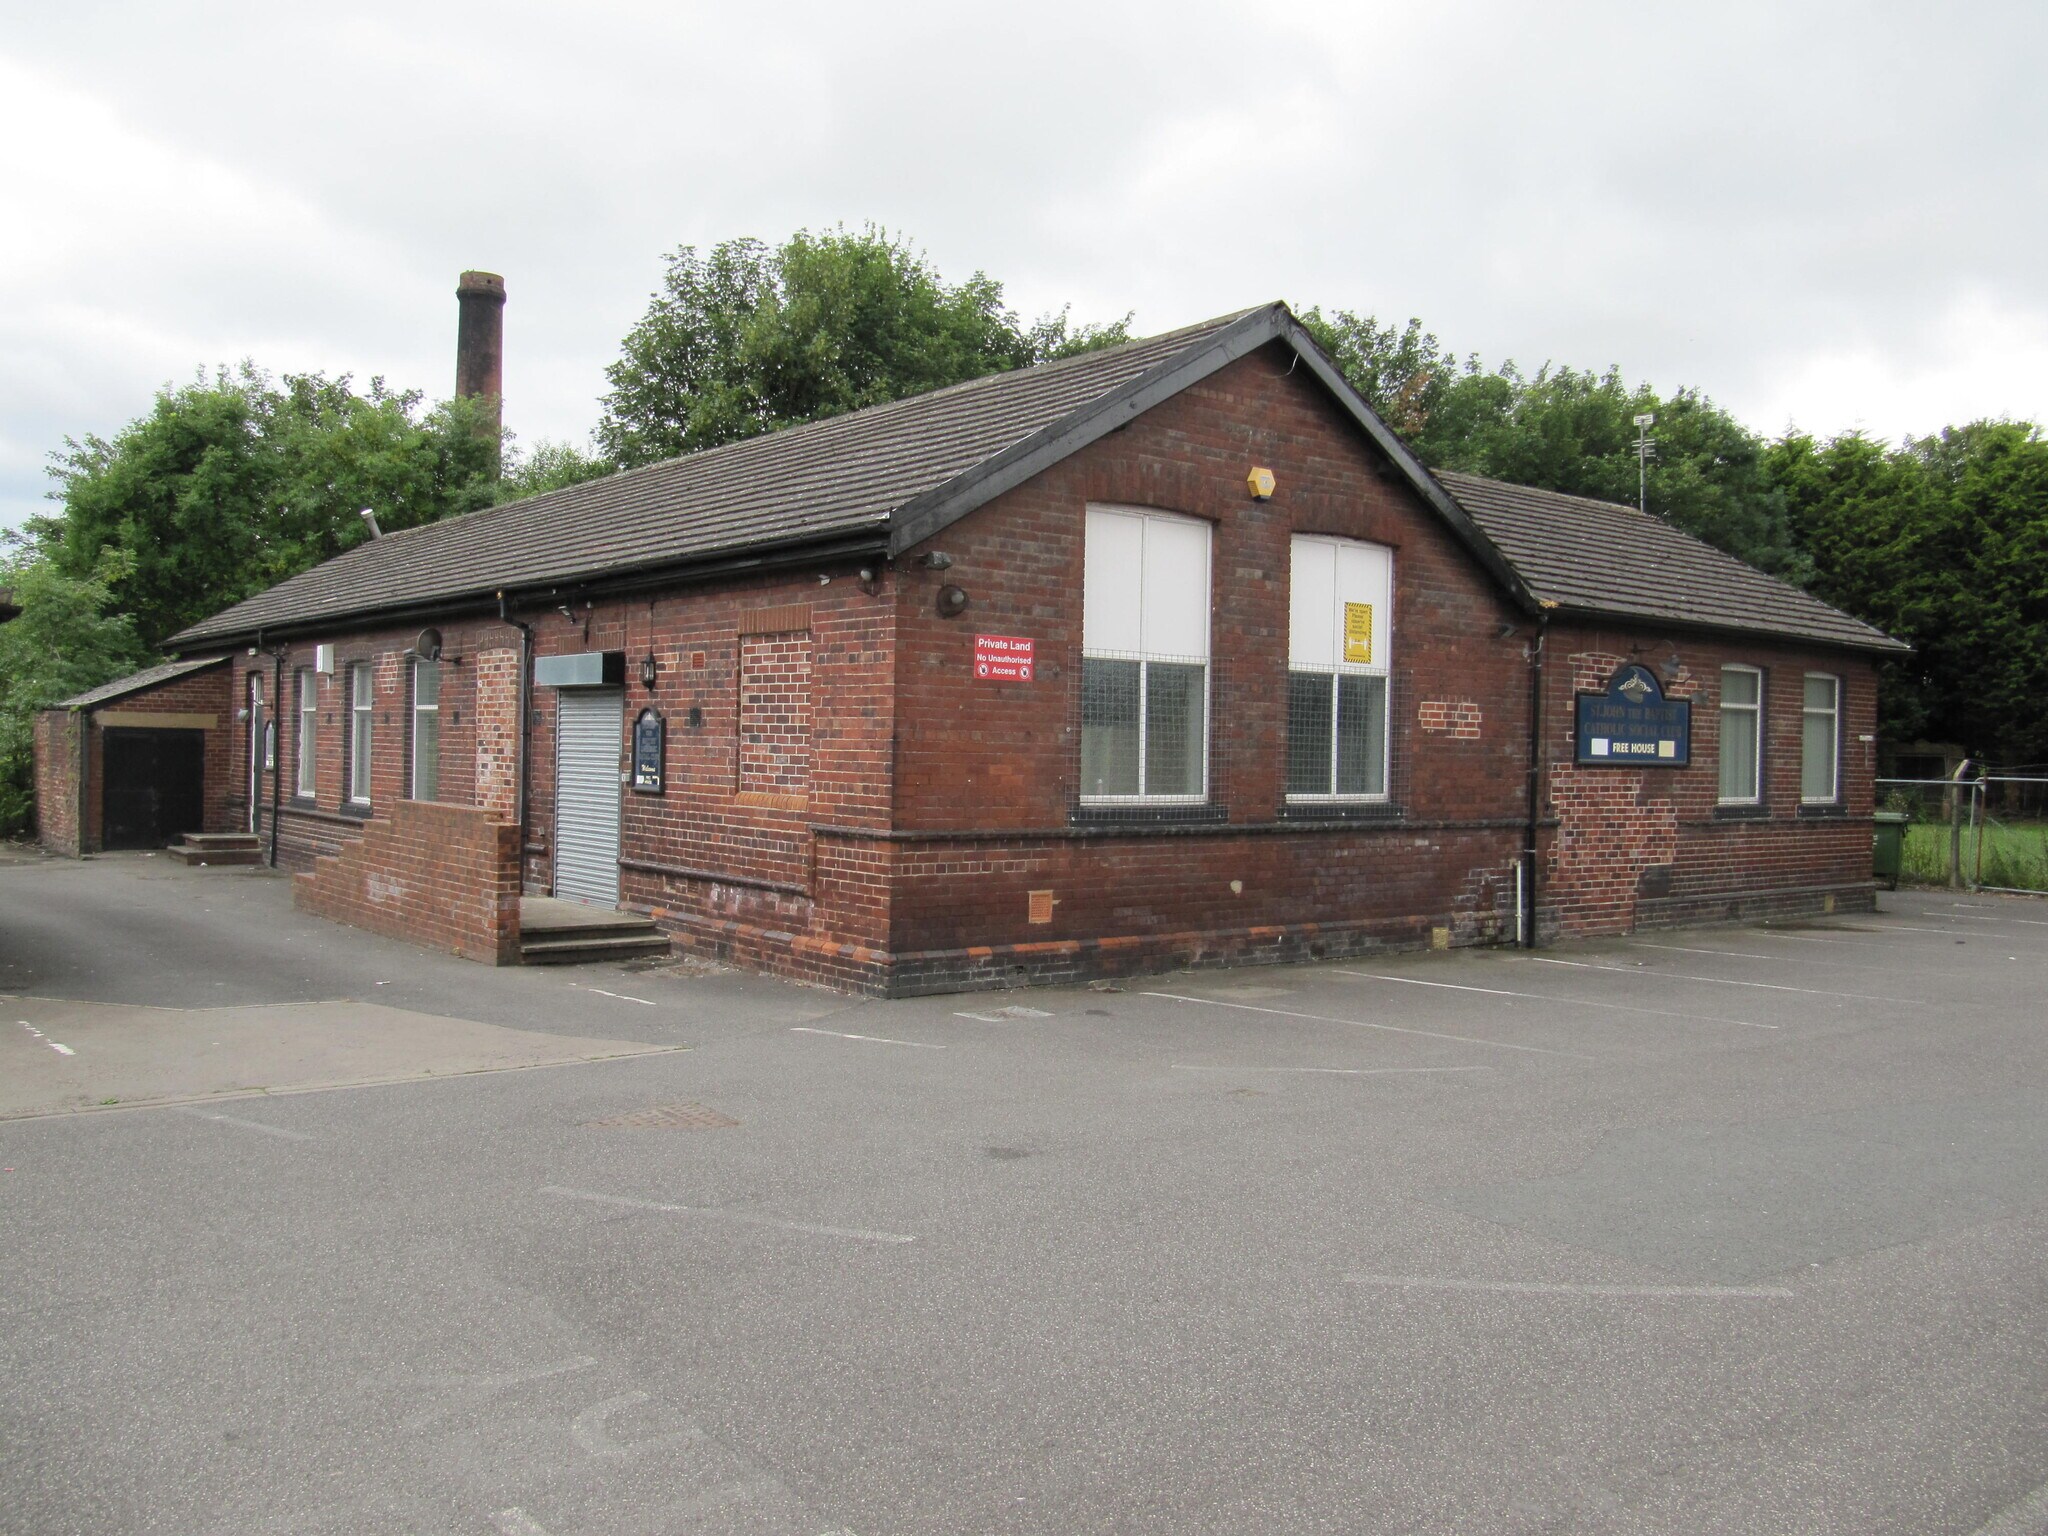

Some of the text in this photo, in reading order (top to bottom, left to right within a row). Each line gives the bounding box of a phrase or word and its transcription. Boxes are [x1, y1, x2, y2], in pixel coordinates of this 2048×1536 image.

[978, 638, 1031, 651] Private Land
[976, 653, 1032, 665] No Unauthorised
[992, 666, 1017, 675] Access
[1644, 707, 1678, 720] BAPTIST
[1584, 722, 1626, 736] CATHOLIC
[1628, 723, 1658, 737] SOCIAL
[1612, 742, 1655, 754] FREE HOUSE
